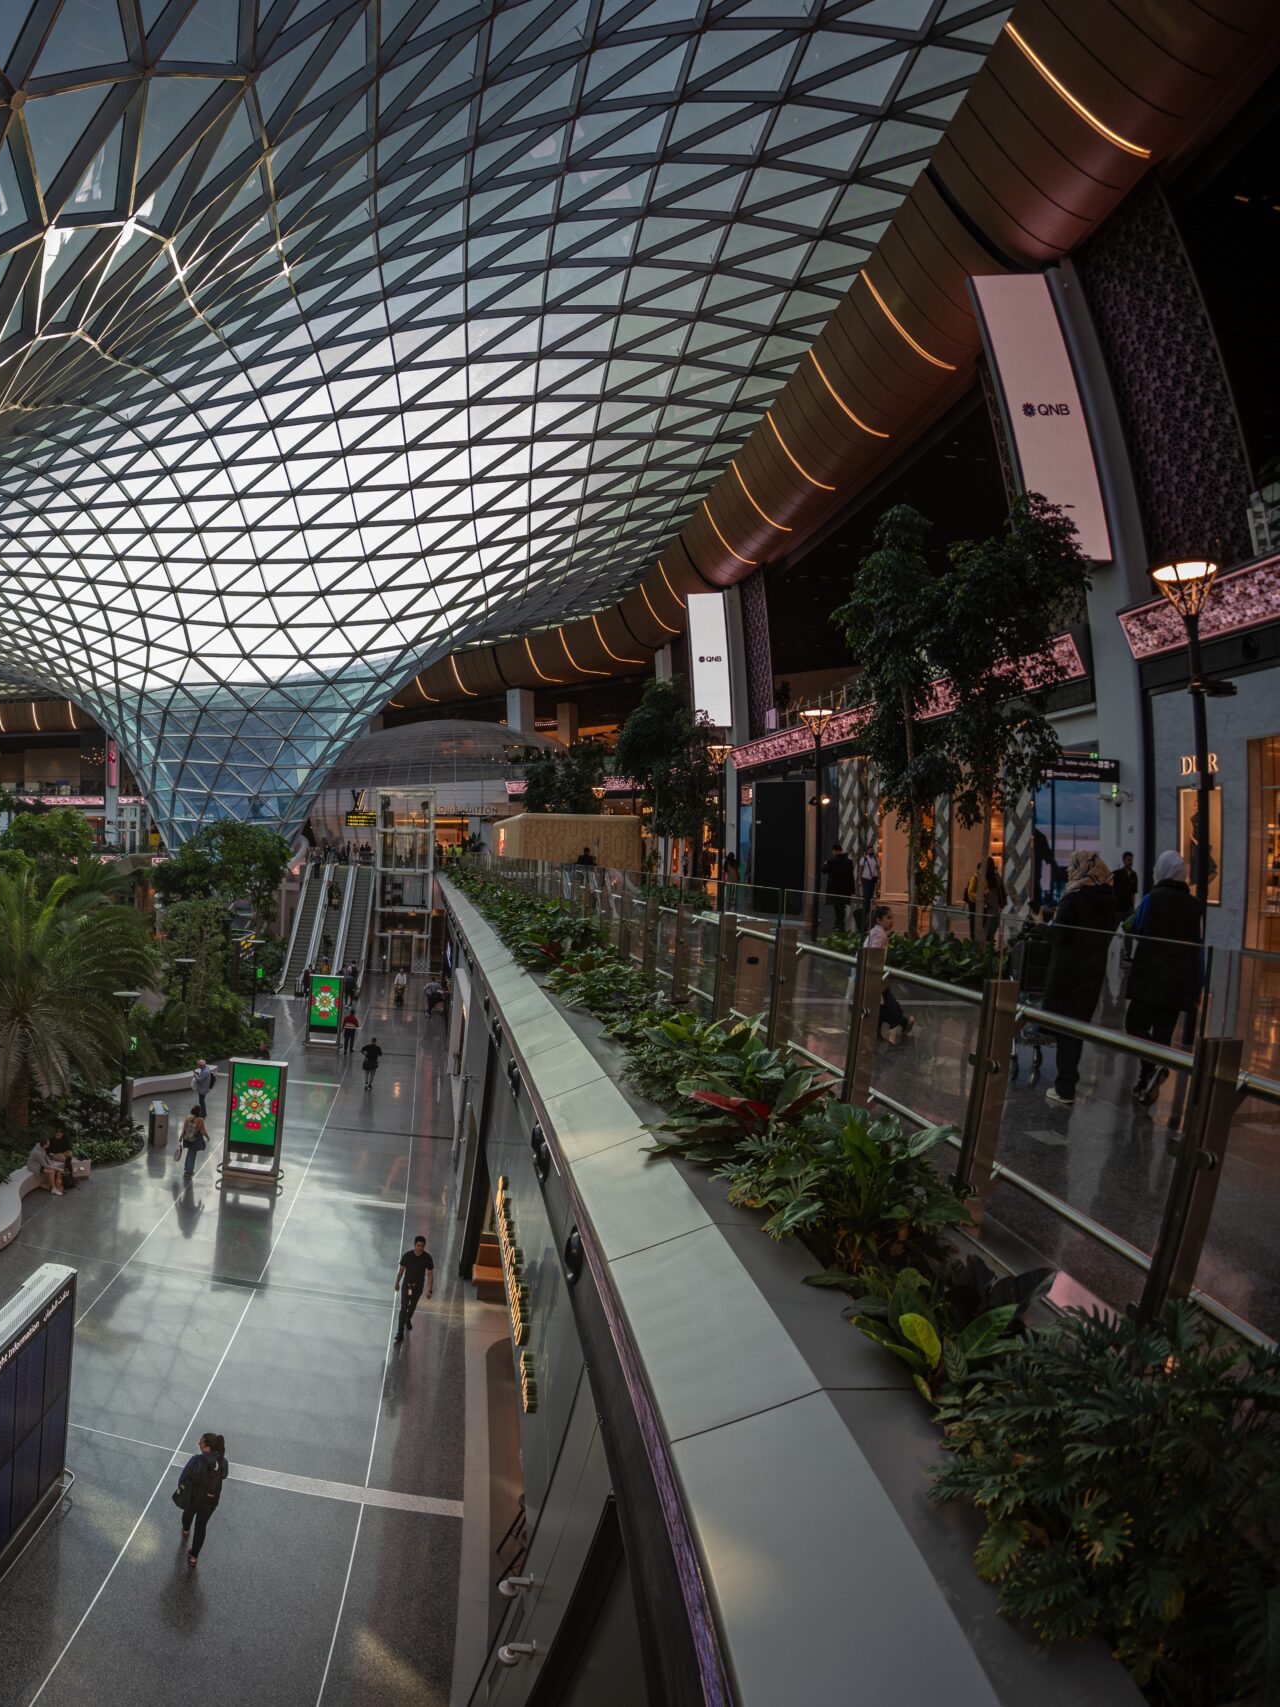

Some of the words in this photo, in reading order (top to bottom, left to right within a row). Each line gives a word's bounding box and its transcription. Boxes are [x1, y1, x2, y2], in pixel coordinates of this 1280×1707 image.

[1037, 403, 1070, 416] QNB
[1180, 752, 1219, 776] DIR
[436, 806, 458, 814] LOUIS
[462, 806, 498, 814] VUITTON
[8, 1320, 40, 1359] Information
